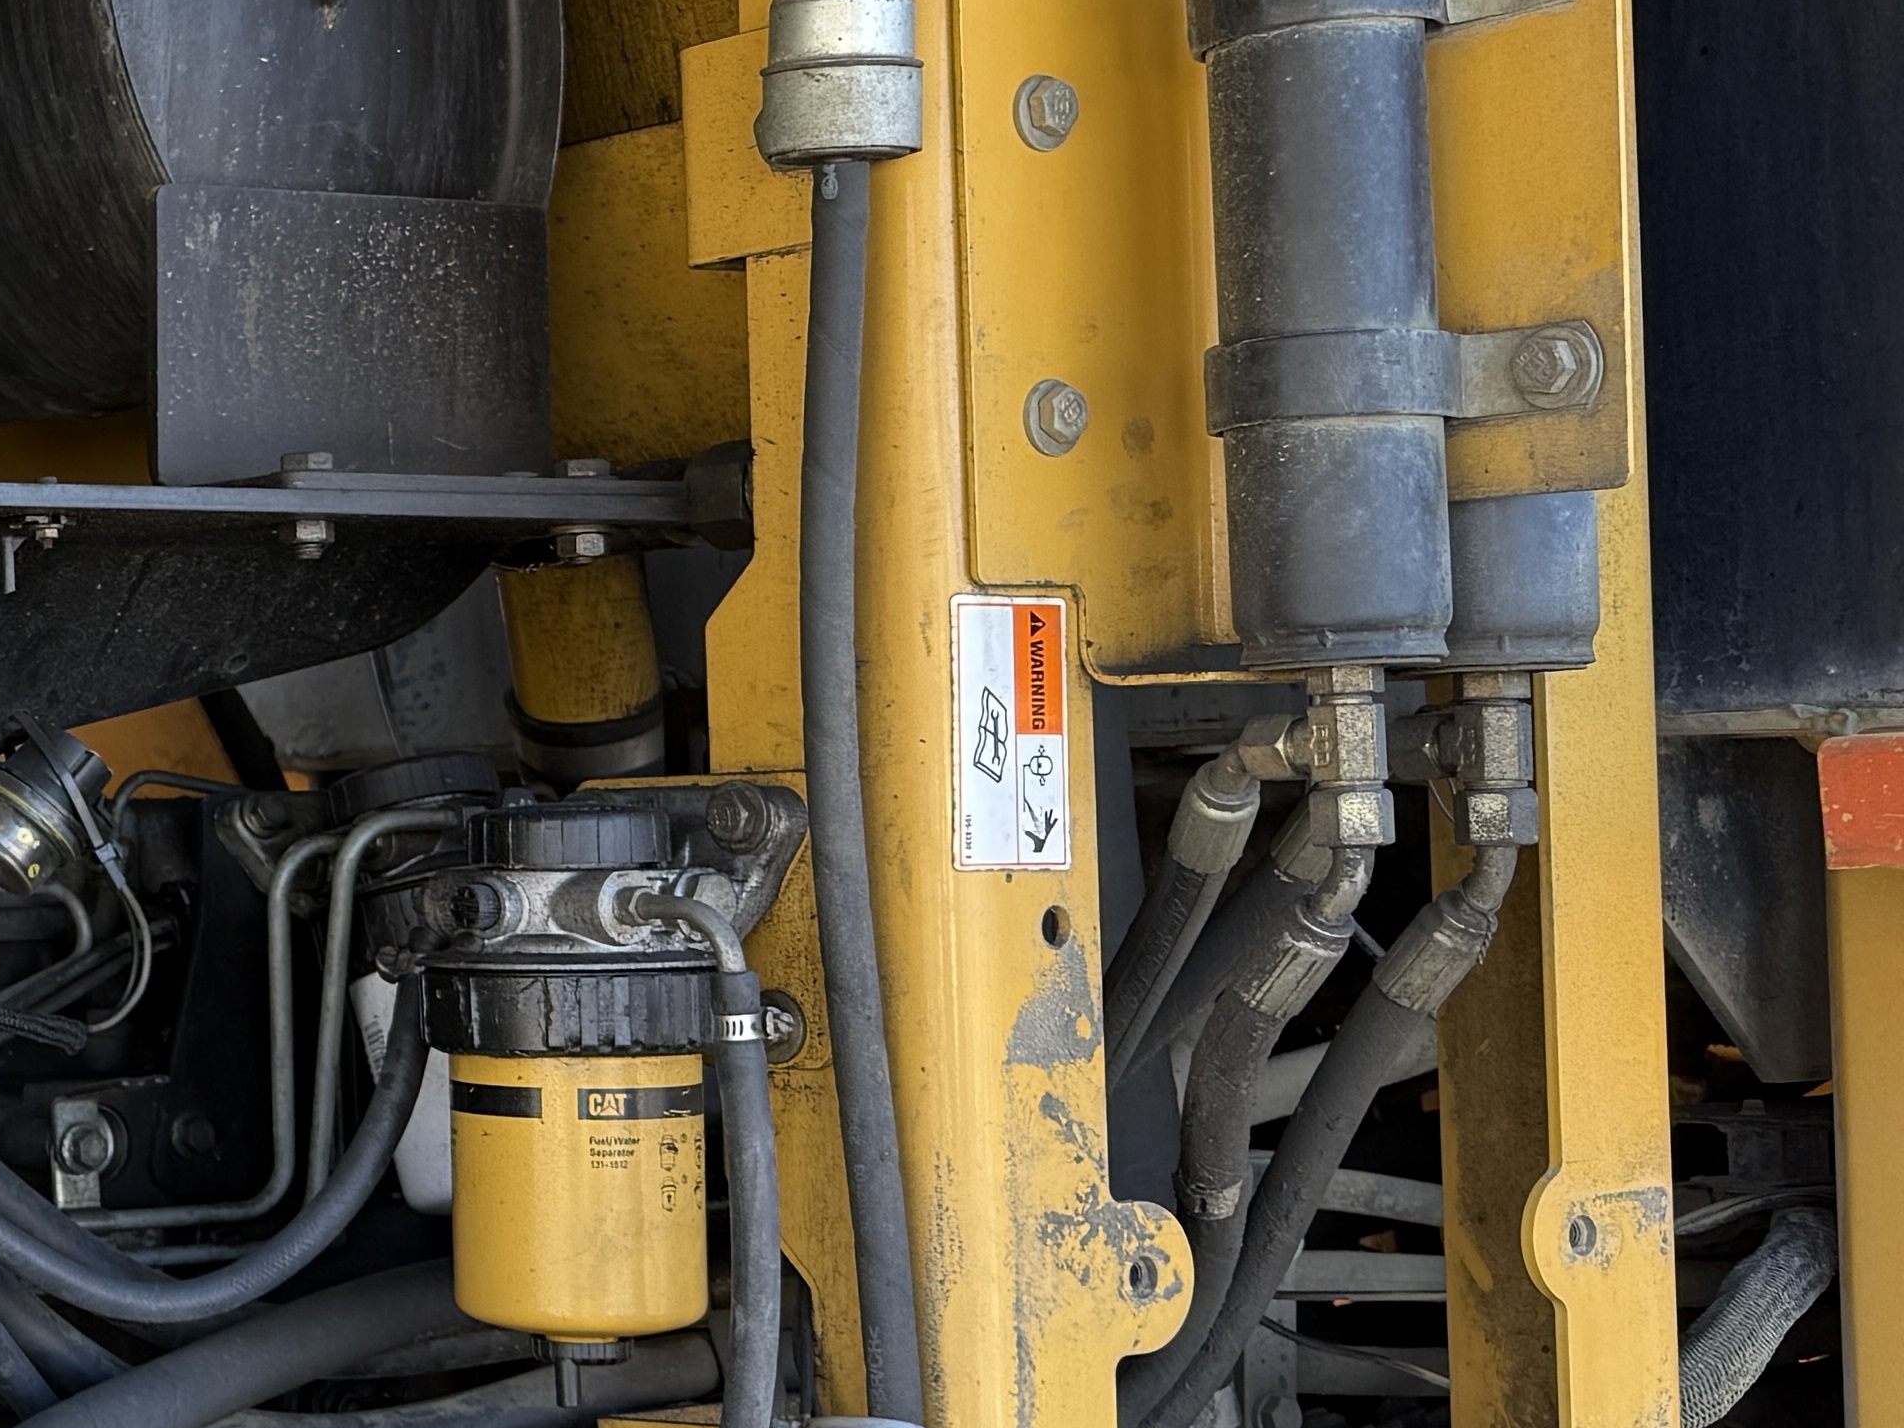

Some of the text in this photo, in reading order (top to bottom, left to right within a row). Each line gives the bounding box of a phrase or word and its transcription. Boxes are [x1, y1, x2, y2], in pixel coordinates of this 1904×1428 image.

[1030, 639, 1046, 730] WARNING
[588, 1092, 628, 1117] CAT
[589, 1148, 636, 1159] Separator
